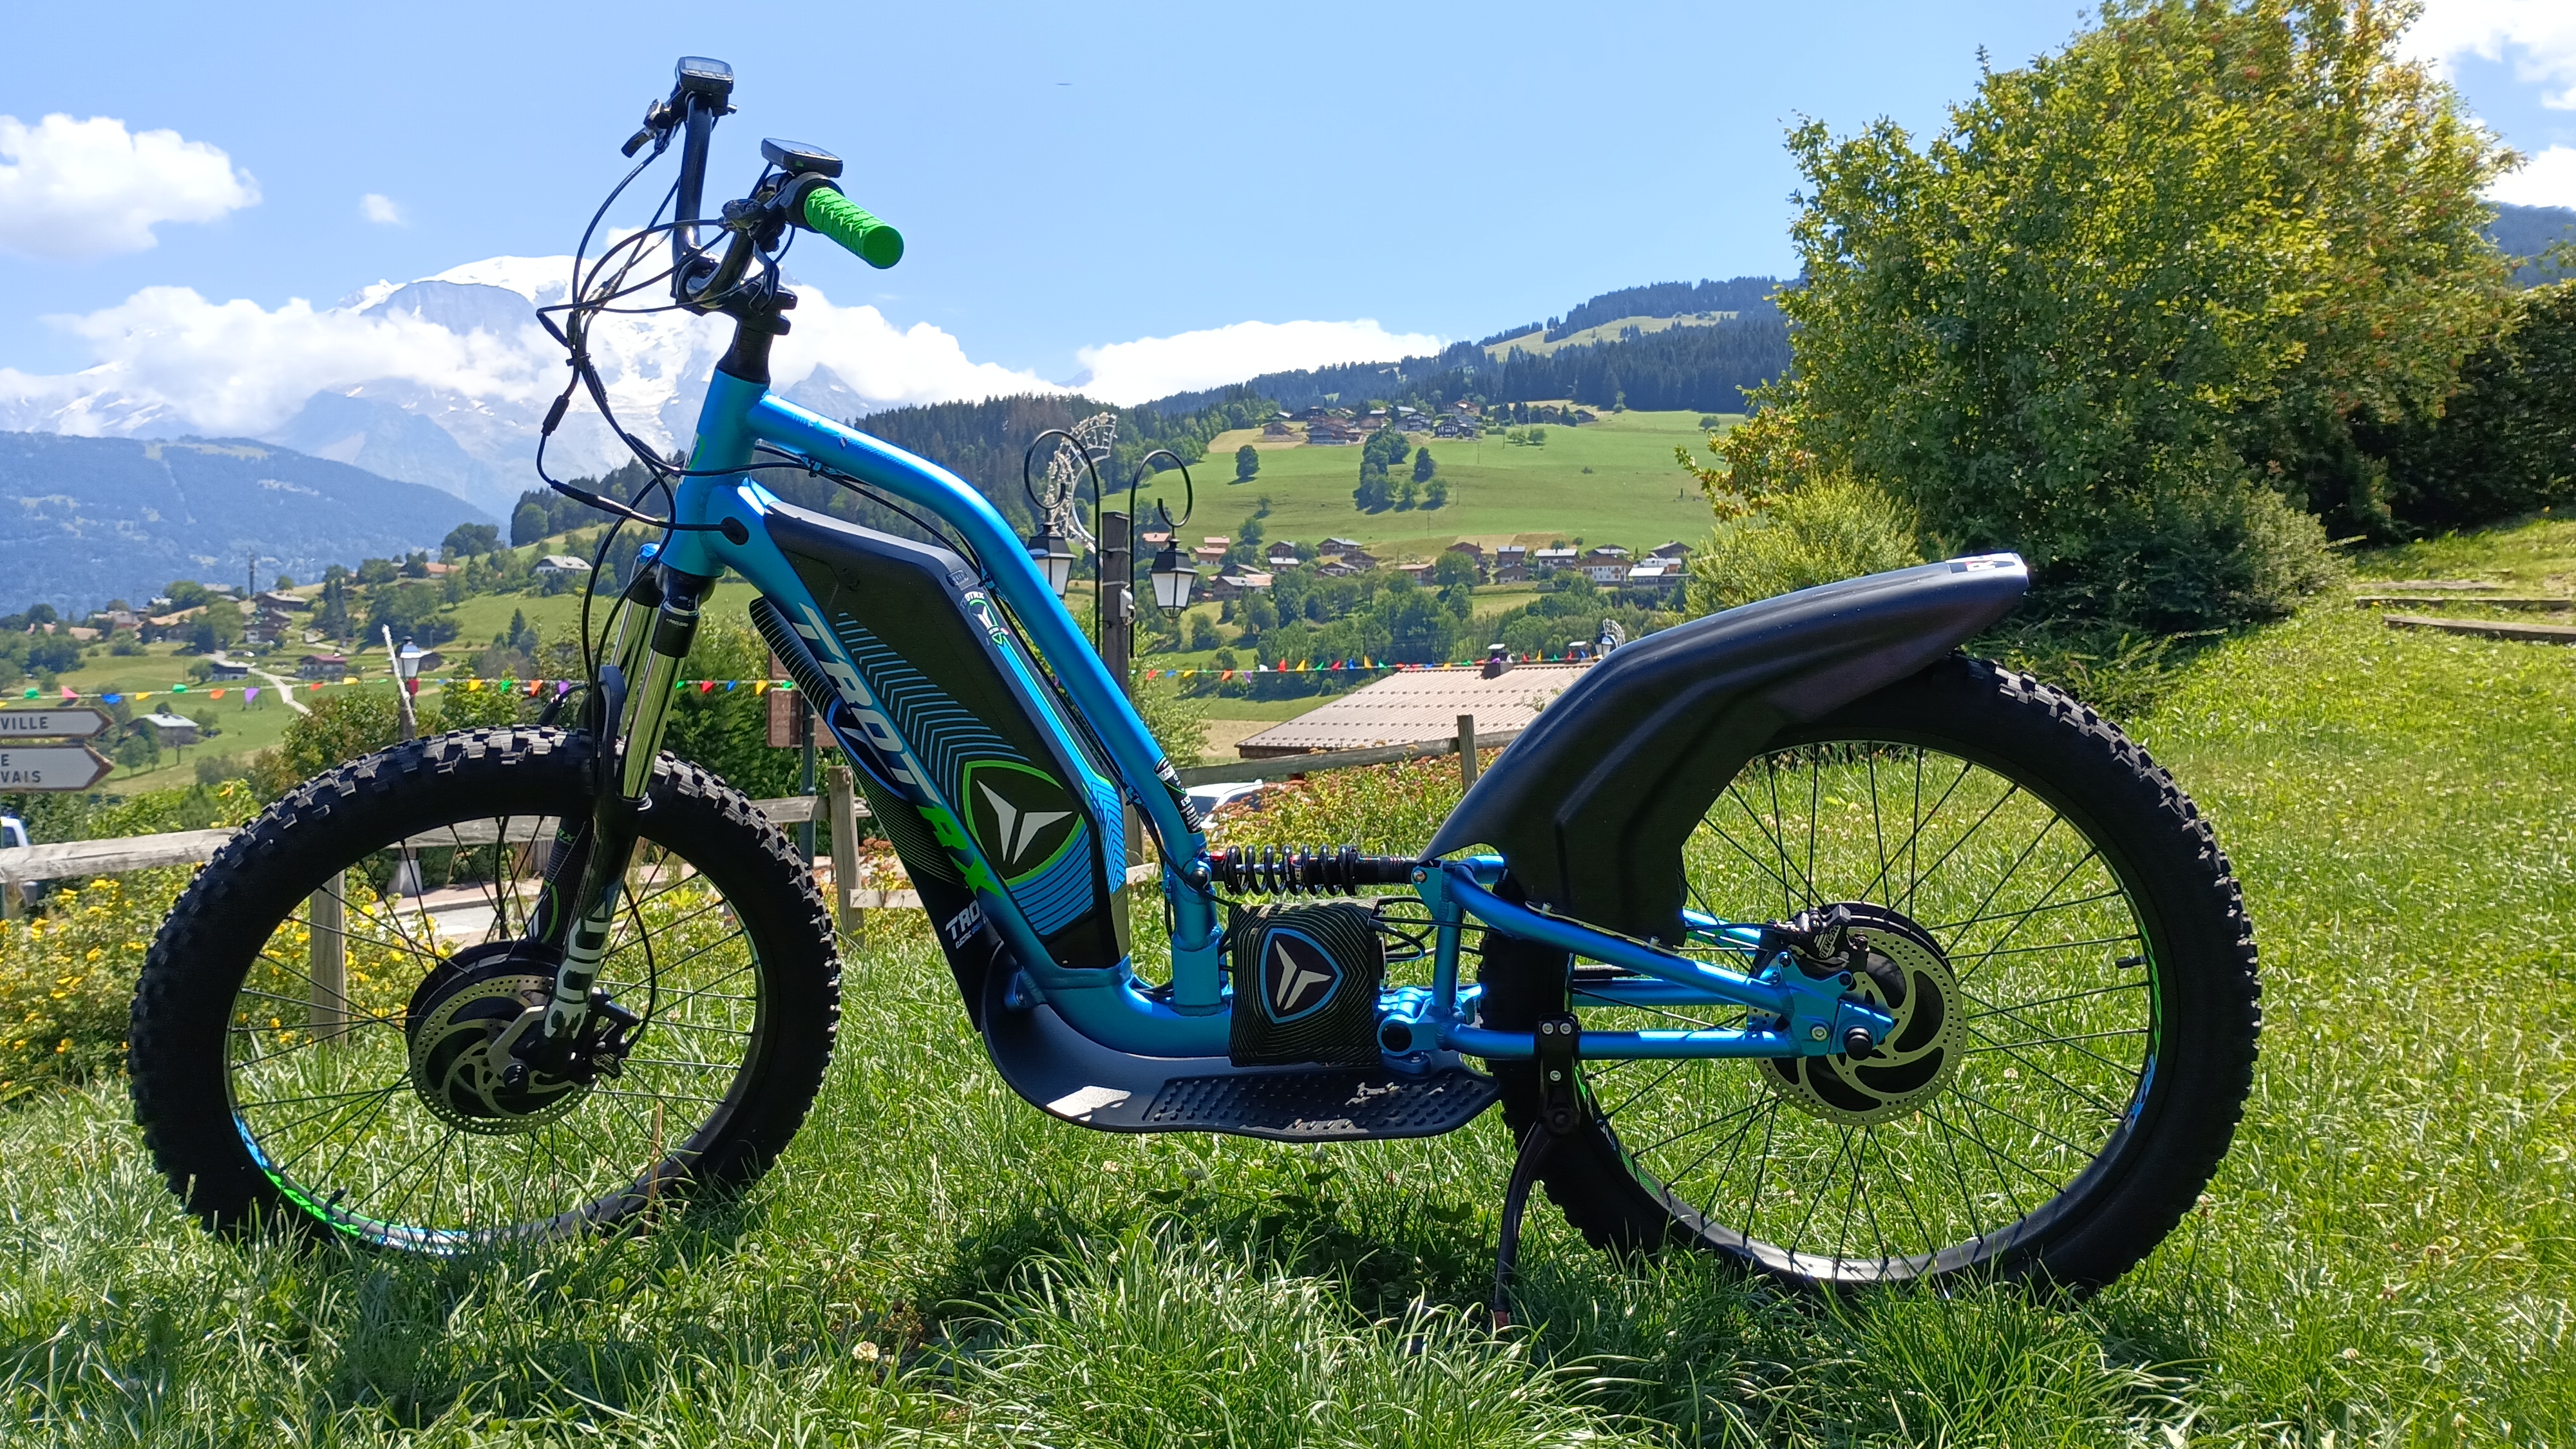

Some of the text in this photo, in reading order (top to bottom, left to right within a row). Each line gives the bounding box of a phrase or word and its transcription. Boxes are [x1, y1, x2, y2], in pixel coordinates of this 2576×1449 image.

[0, 716, 48, 730] VILLE
[1, 754, 10, 766] E
[0, 770, 41, 783] VAIS
[945, 900, 980, 940] TRO
